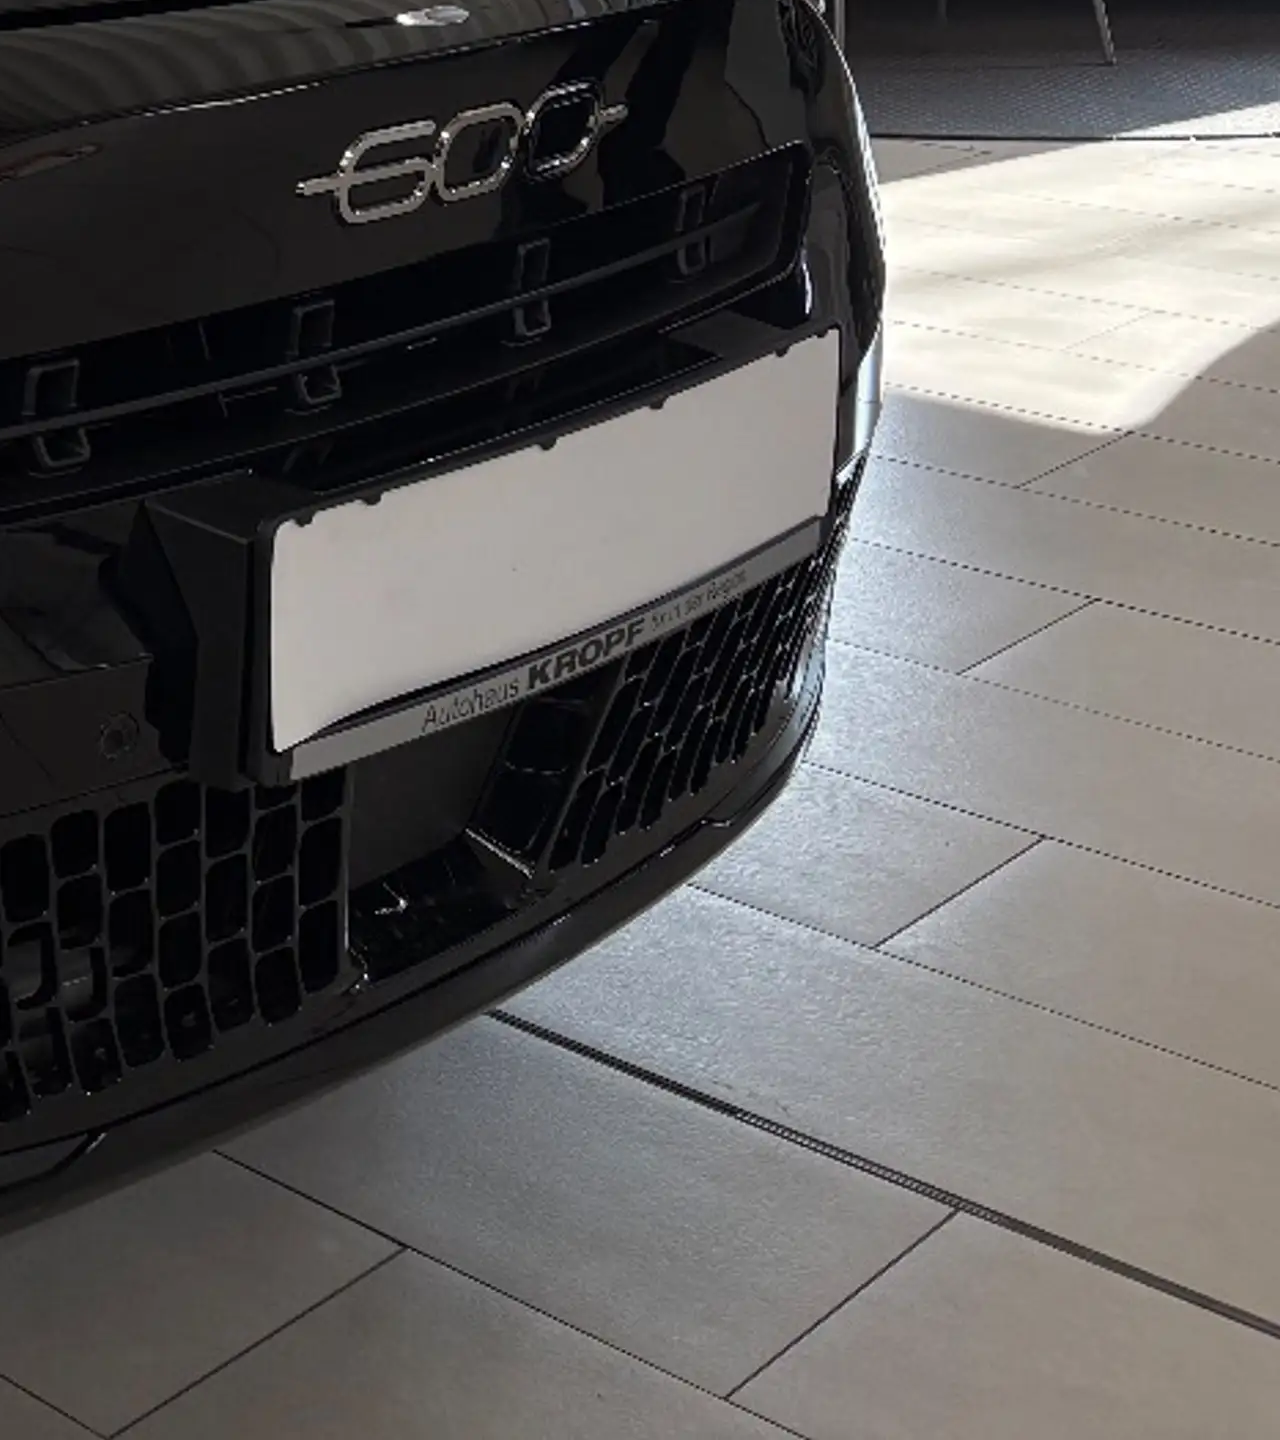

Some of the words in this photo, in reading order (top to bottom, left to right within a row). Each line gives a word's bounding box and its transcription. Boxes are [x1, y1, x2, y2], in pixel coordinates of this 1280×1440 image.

[296, 78, 628, 224] 600
[421, 677, 519, 732] Autohaus
[527, 617, 645, 690] KROPF
